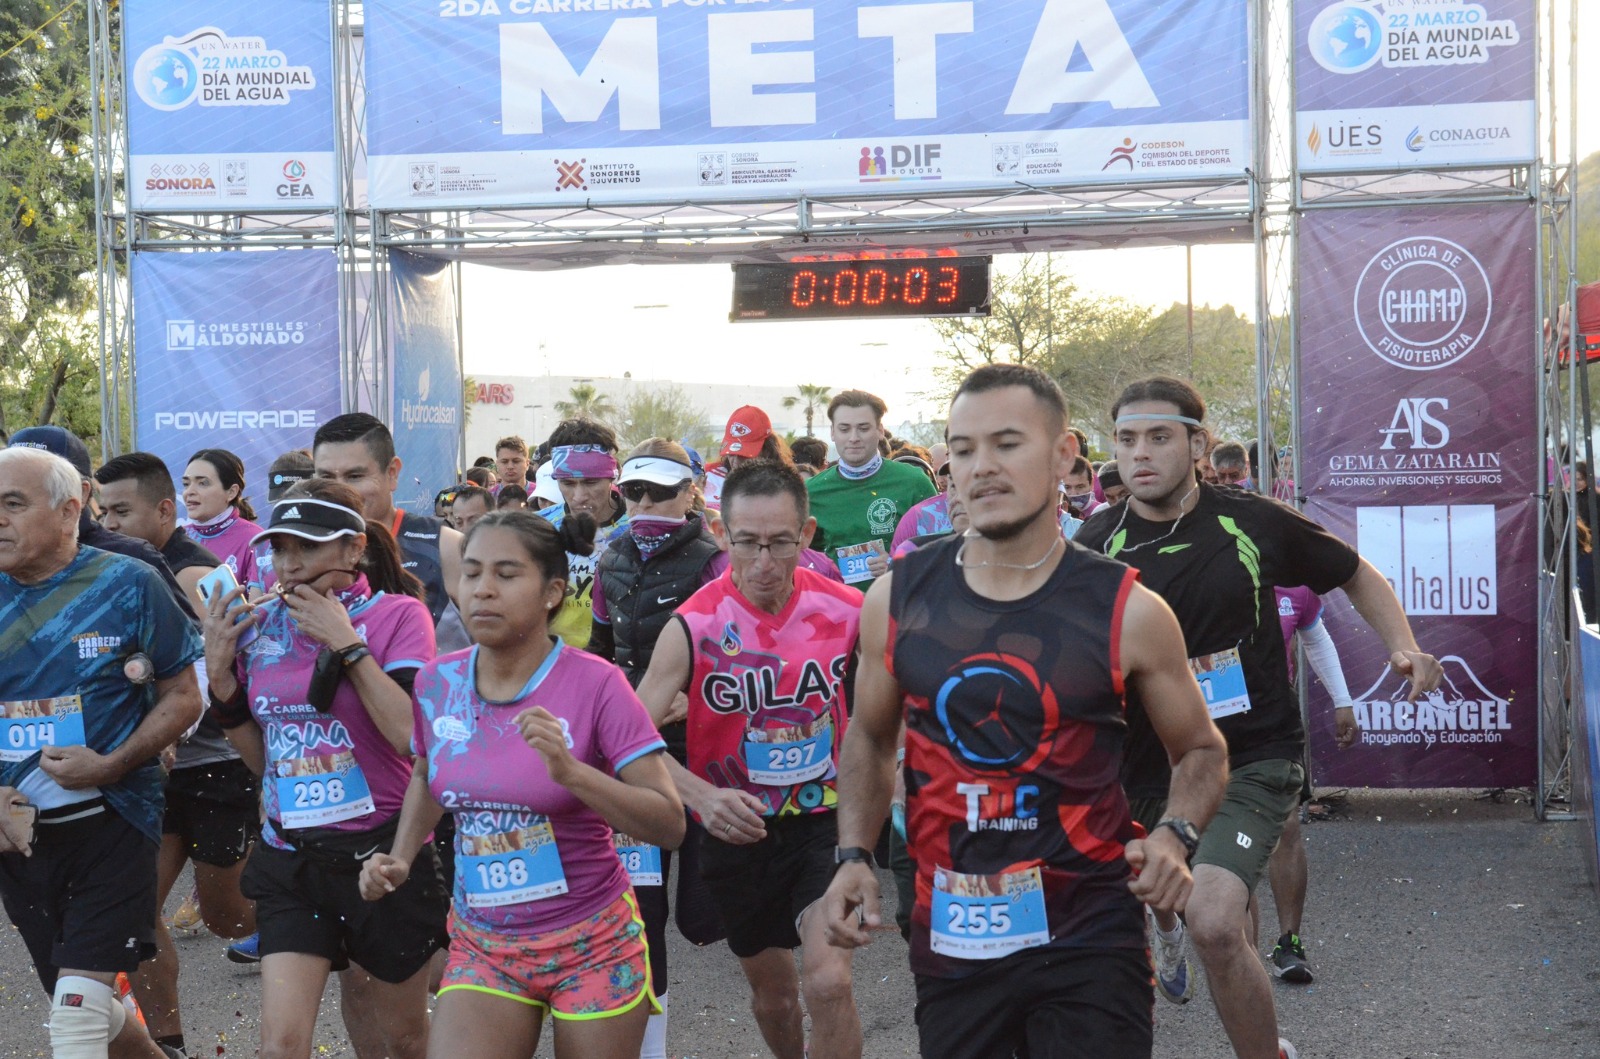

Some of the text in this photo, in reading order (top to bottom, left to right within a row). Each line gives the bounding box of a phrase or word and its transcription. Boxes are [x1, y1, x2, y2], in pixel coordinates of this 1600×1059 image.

[439, 0, 500, 17] 2DA
[1388, 10, 1480, 27] 22 MARZO
[1388, 26, 1513, 45] DÍA MUNDIAL
[1388, 44, 1482, 61] DEL AGUA
[202, 55, 281, 69] 22 MARZO
[500, 0, 1161, 135] META
[203, 70, 310, 86] DÍA MUNDIAL
[203, 87, 284, 101] DEL AGUA
[1328, 125, 1382, 147] UES
[1429, 126, 1511, 141] CONAGUA
[1031, 147, 1058, 155] SONORA
[1141, 140, 1185, 149] CODESON
[891, 143, 942, 168] DIF
[1141, 151, 1178, 160] COMISIÓN
[1195, 148, 1230, 157] DEPORTE
[1157, 158, 1186, 167] ESTADO
[1187, 157, 1198, 166] DE
[1199, 156, 1231, 165] SONORA
[590, 169, 641, 177] SONORENSE
[891, 167, 942, 175] SONORA
[146, 177, 216, 191] SONORA
[596, 176, 641, 184] JUVENTUD
[276, 183, 314, 197] CEA
[1380, 244, 1463, 271] CLÍNICA DE
[792, 265, 960, 307] 0:00:03
[1385, 287, 1462, 324] CHAMP
[1377, 332, 1473, 363] FISIOTERAPIA
[402, 399, 456, 431] Hydrocalsan
[1379, 397, 1450, 450] AIS
[1329, 452, 1501, 471] GEMA ZATARAIN
[1378, 475, 1446, 486] INVERSIONES
[1446, 475, 1453, 484] Y
[1454, 473, 1502, 485] SEGUROS
[78, 636, 121, 649] CARRERA
[79, 647, 98, 659] SAC
[1197, 677, 1214, 701] 1
[8, 722, 55, 748] 014
[1361, 731, 1421, 746] Apoyando
[1439, 729, 1502, 744] Educación
[768, 740, 816, 770] 297
[294, 778, 346, 808] 298
[462, 800, 532, 812] CARRERA
[477, 857, 529, 891] 188
[948, 901, 1012, 936] 255
